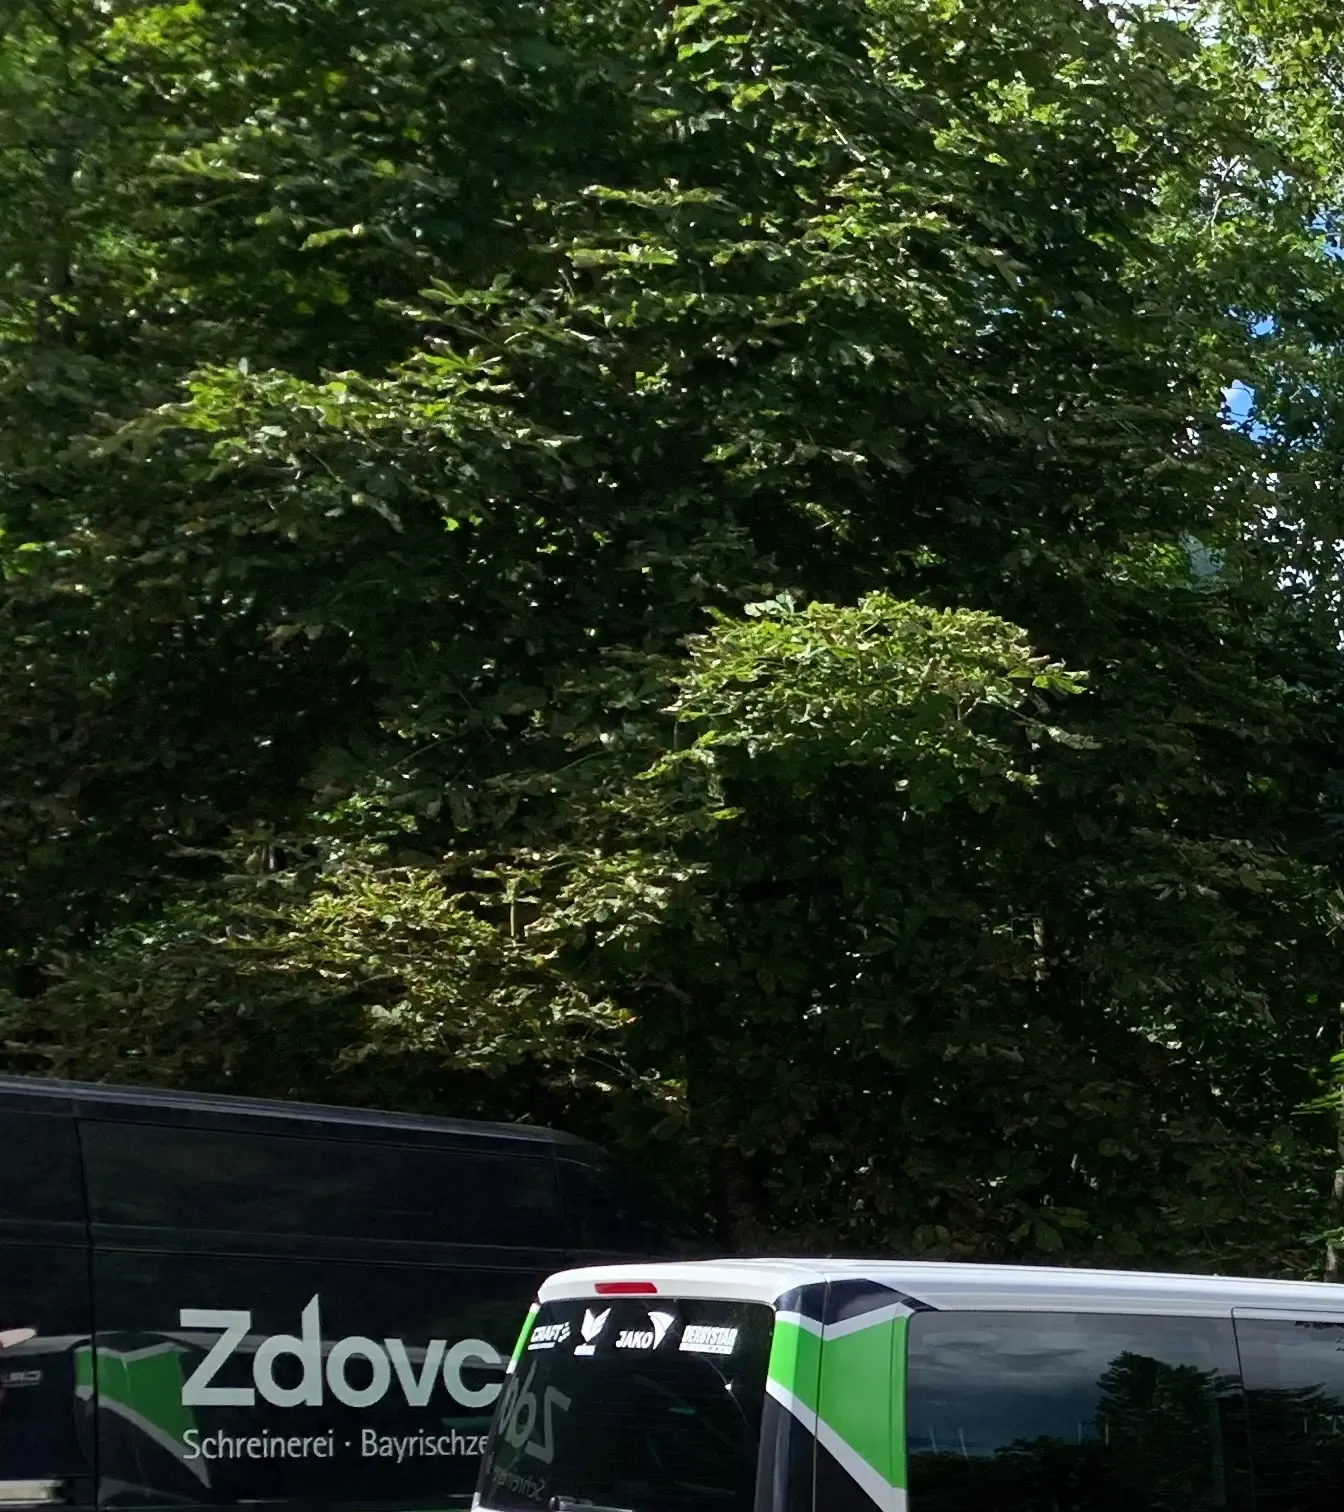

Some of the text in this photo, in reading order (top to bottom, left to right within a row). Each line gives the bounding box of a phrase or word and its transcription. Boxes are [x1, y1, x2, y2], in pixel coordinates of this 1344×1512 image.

[180, 1293, 503, 1408] Zdovc
[616, 1330, 653, 1348] JAKO
[182, 1428, 334, 1460] Schreinerei
